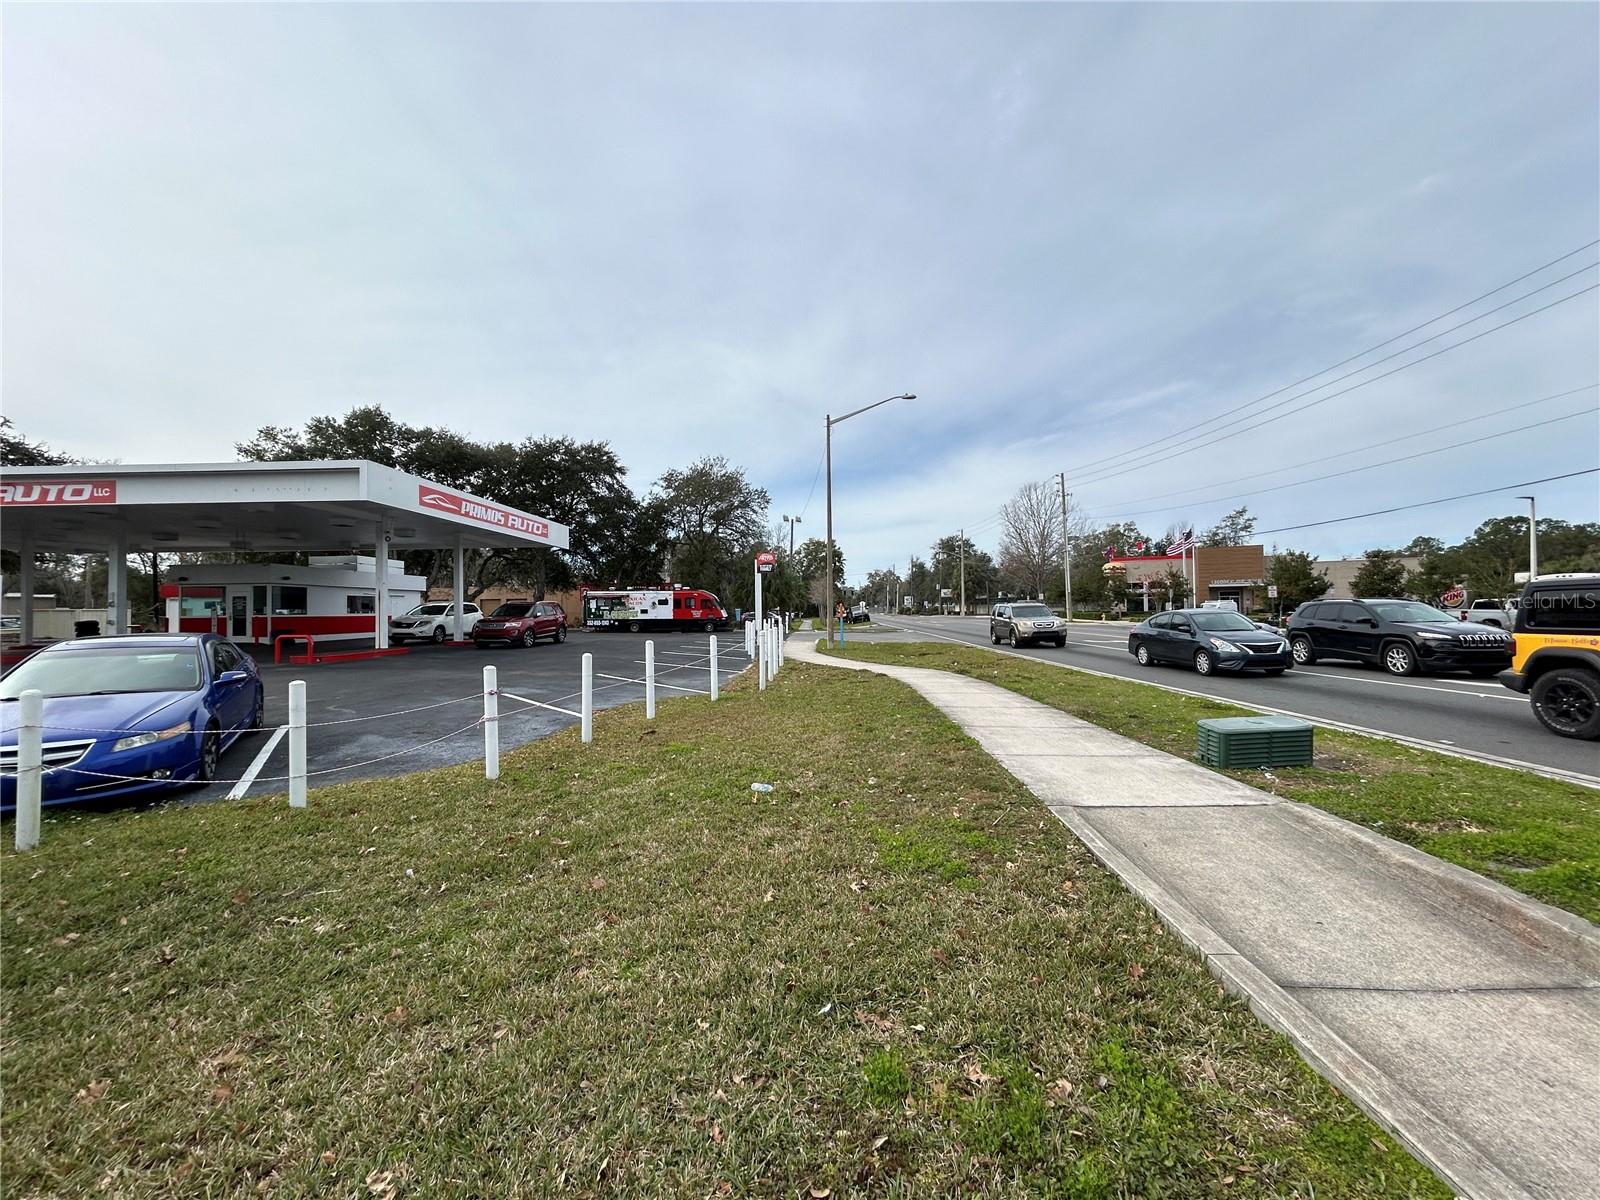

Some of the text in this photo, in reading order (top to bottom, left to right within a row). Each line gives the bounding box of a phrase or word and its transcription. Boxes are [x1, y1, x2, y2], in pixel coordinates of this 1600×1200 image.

[0, 484, 111, 502] AUTO LLC
[461, 501, 543, 535] PRIMOS AUTO
[1442, 591, 1464, 603] KING
